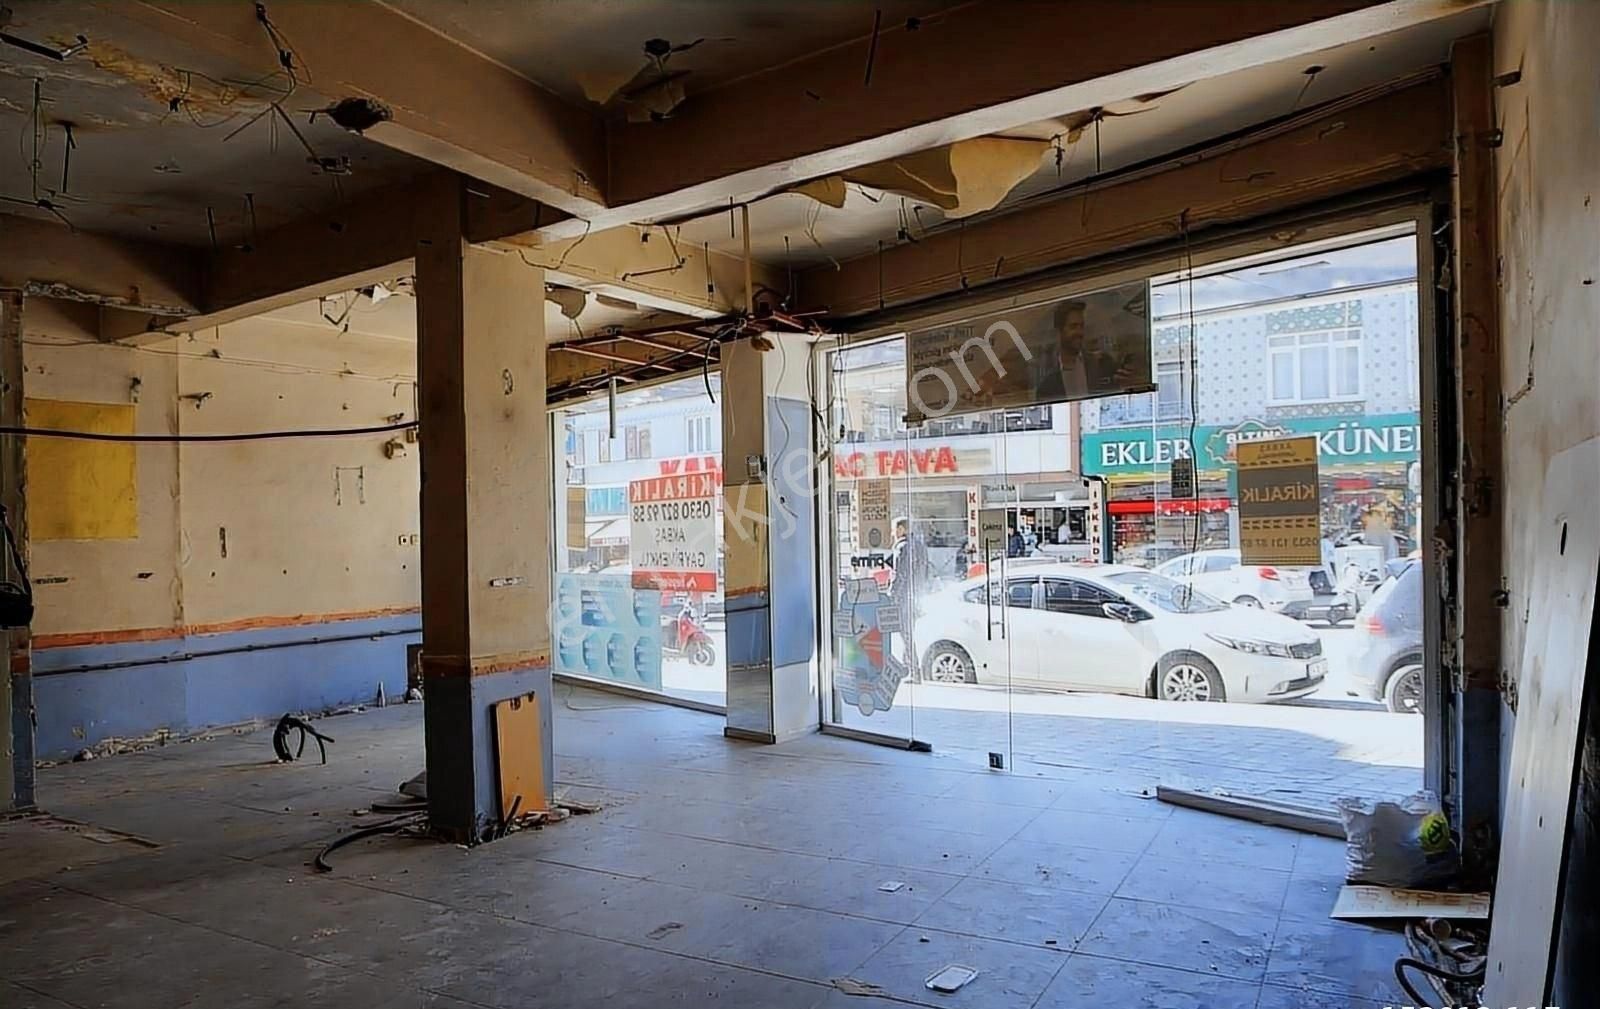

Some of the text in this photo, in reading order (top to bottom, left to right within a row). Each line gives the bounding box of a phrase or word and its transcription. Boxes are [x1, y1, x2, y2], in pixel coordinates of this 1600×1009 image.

[1101, 437, 1193, 467] EKLER
[1315, 422, 1421, 456] KÜNE
[874, 445, 956, 475] TAVA
